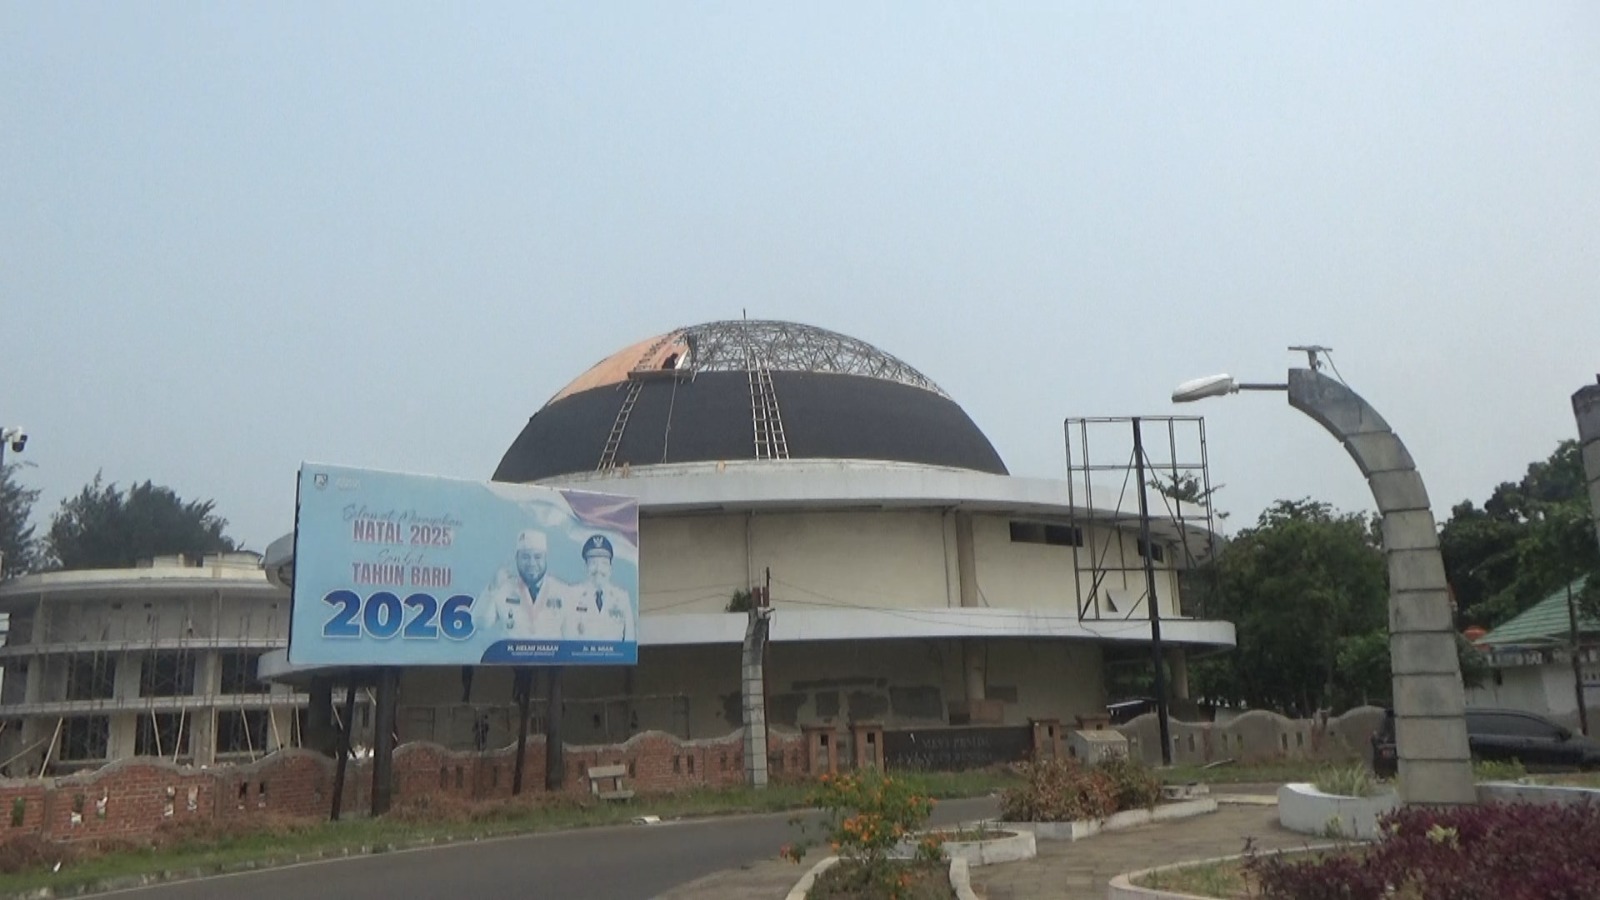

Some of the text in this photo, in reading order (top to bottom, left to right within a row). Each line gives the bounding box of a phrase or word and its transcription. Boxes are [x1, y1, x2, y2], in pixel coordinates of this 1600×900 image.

[353, 519, 453, 547] NATAL 2025
[352, 562, 452, 588] TAHUN BARU
[322, 590, 475, 640] 2026
